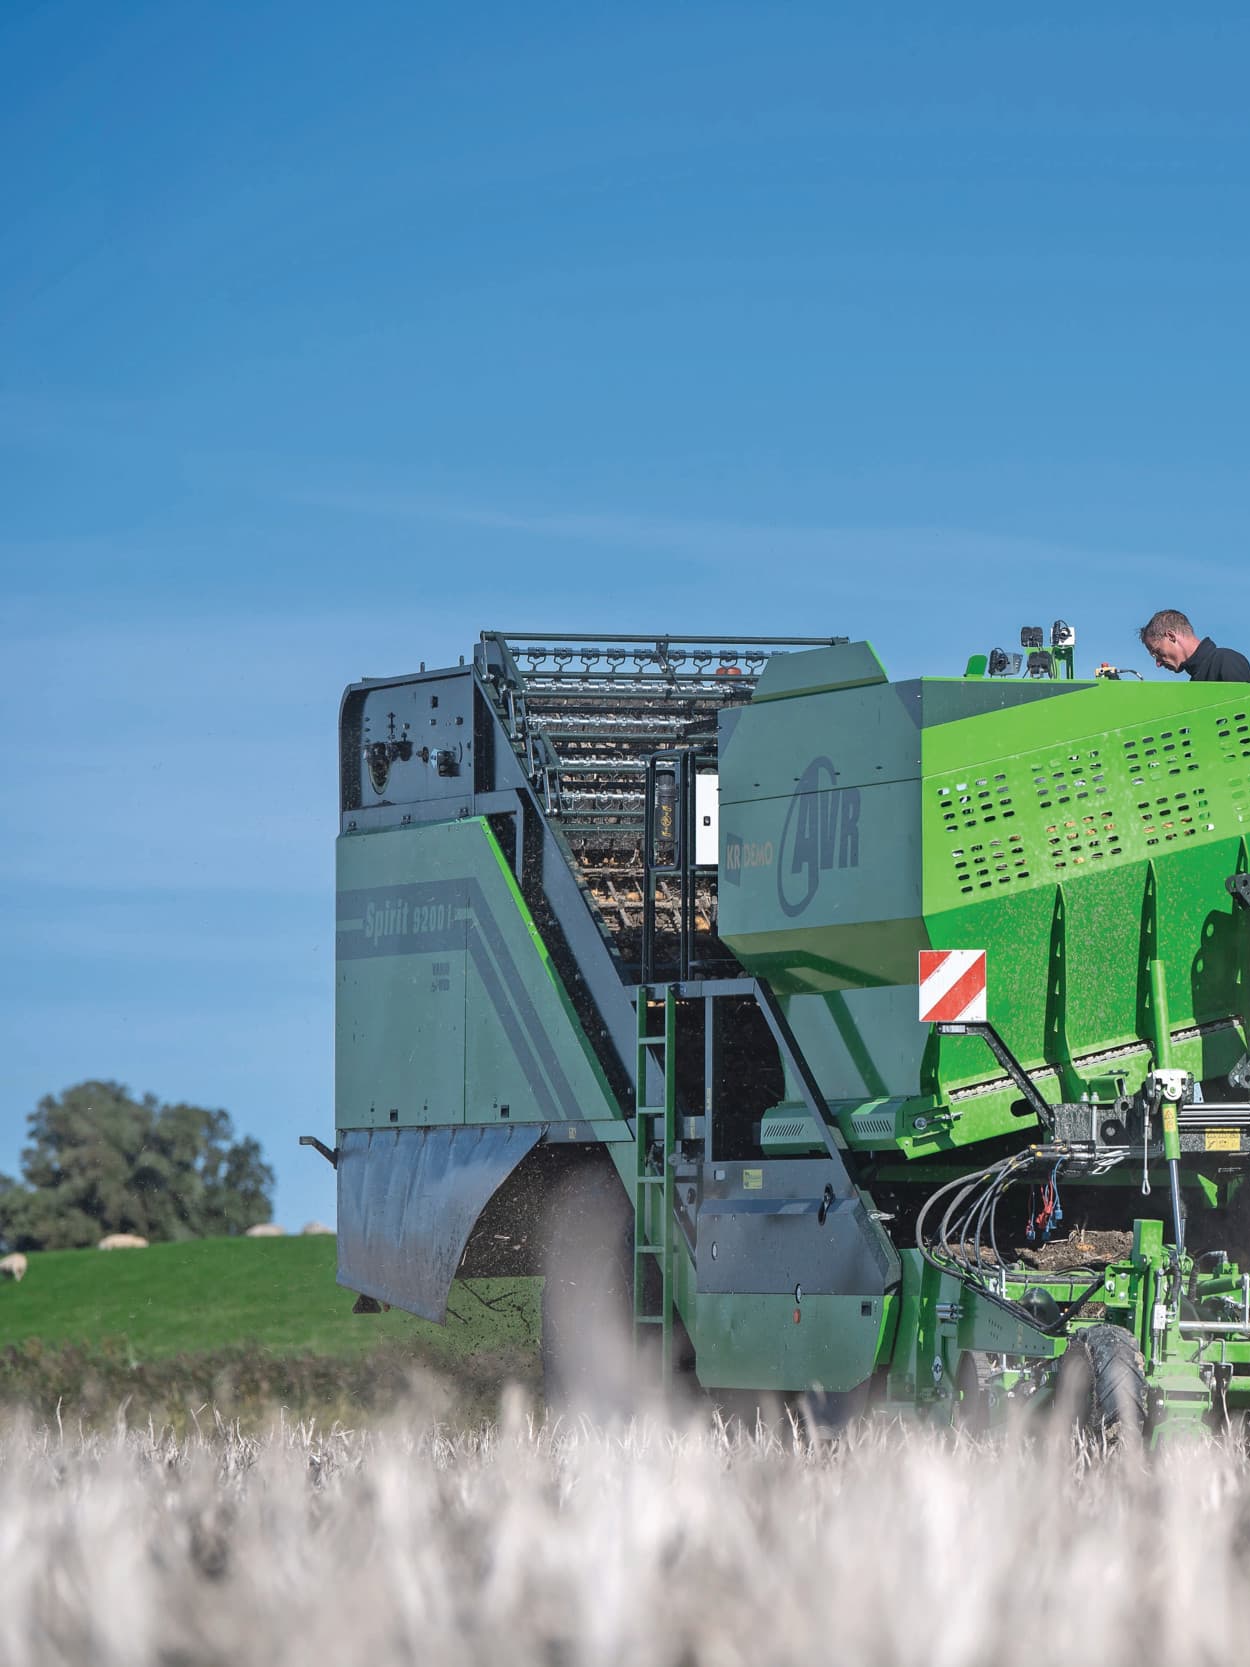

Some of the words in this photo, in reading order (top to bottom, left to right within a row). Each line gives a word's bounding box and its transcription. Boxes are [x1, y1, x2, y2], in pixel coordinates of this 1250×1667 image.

[726, 844, 741, 870] KR
[743, 841, 774, 868] DEMO
[777, 756, 861, 918] AVR
[365, 899, 409, 947] Spirit
